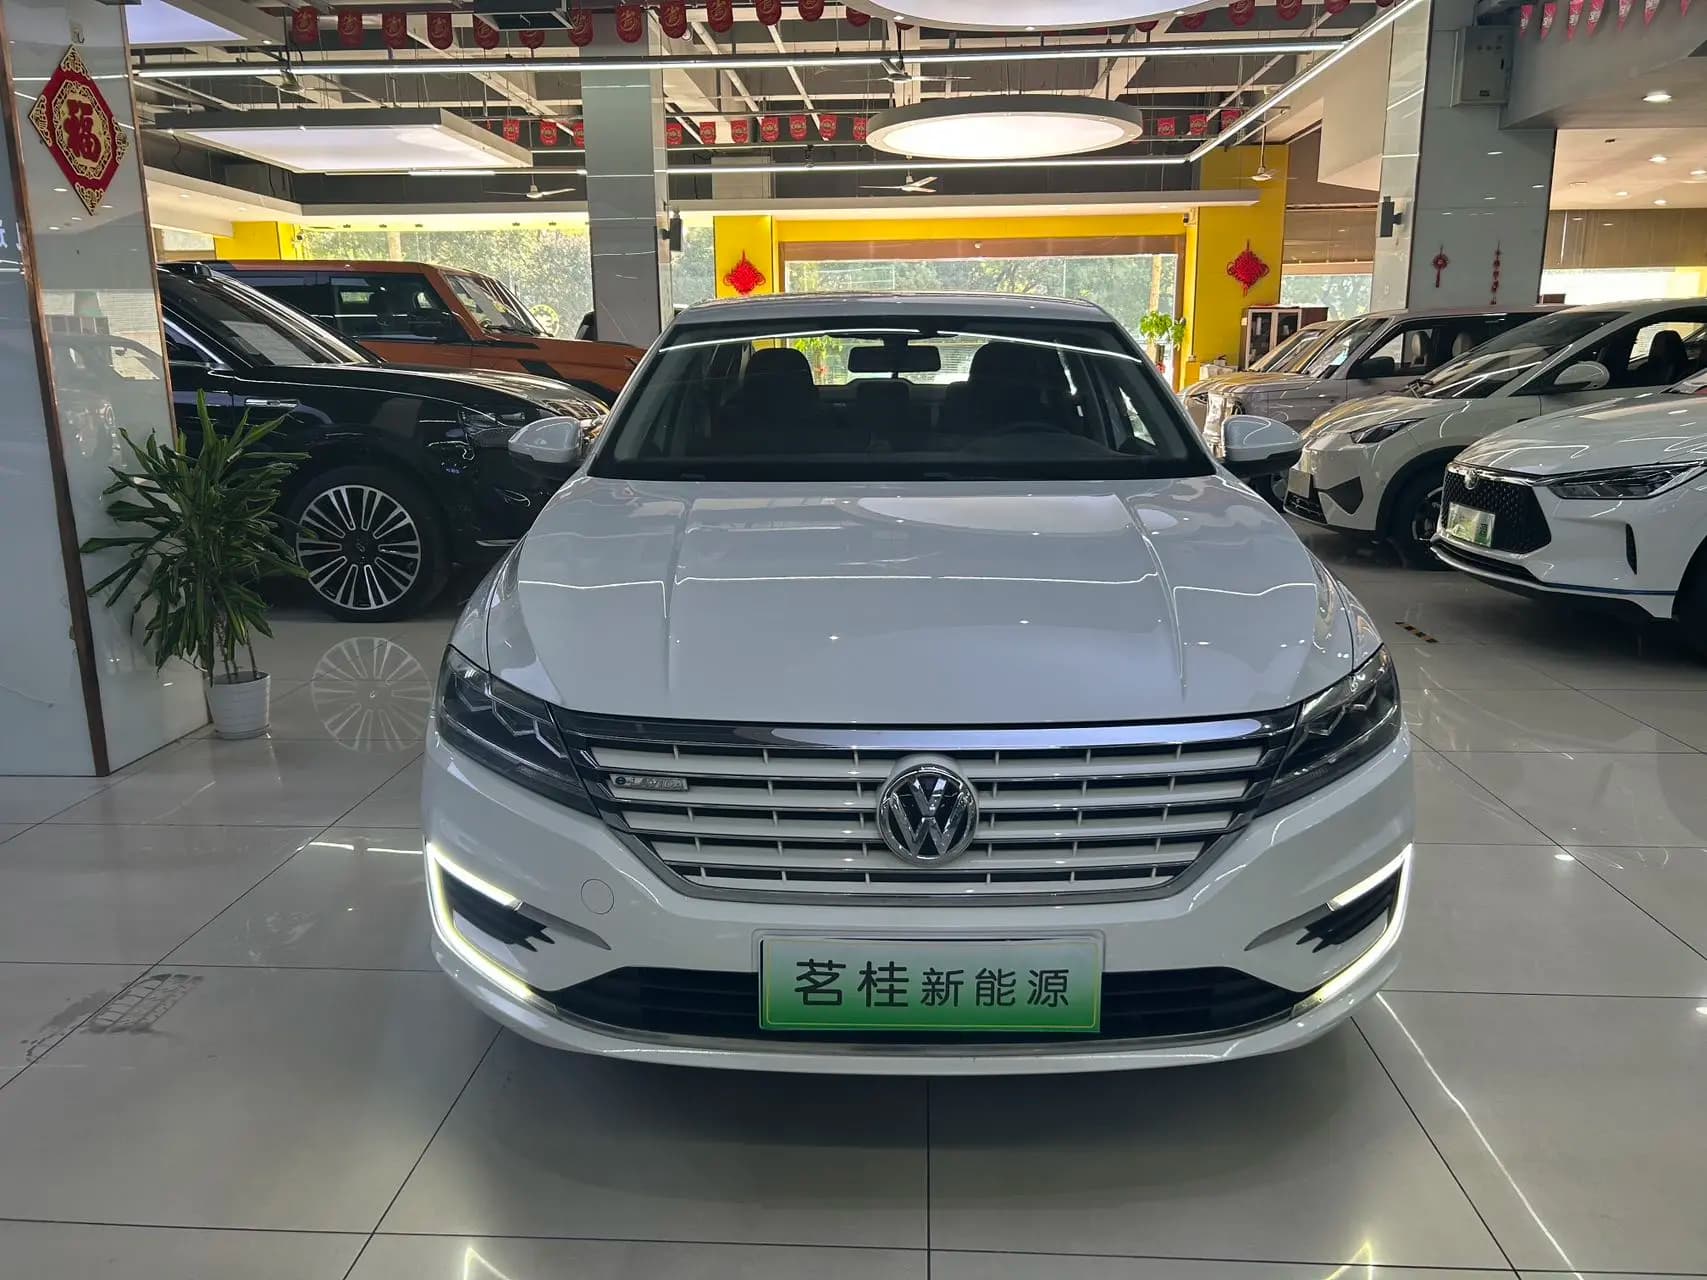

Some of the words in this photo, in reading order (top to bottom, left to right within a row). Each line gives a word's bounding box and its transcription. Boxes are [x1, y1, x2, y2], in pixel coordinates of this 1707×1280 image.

[62, 98, 102, 164] 福
[794, 958, 1070, 1008] 茗桂新能源
